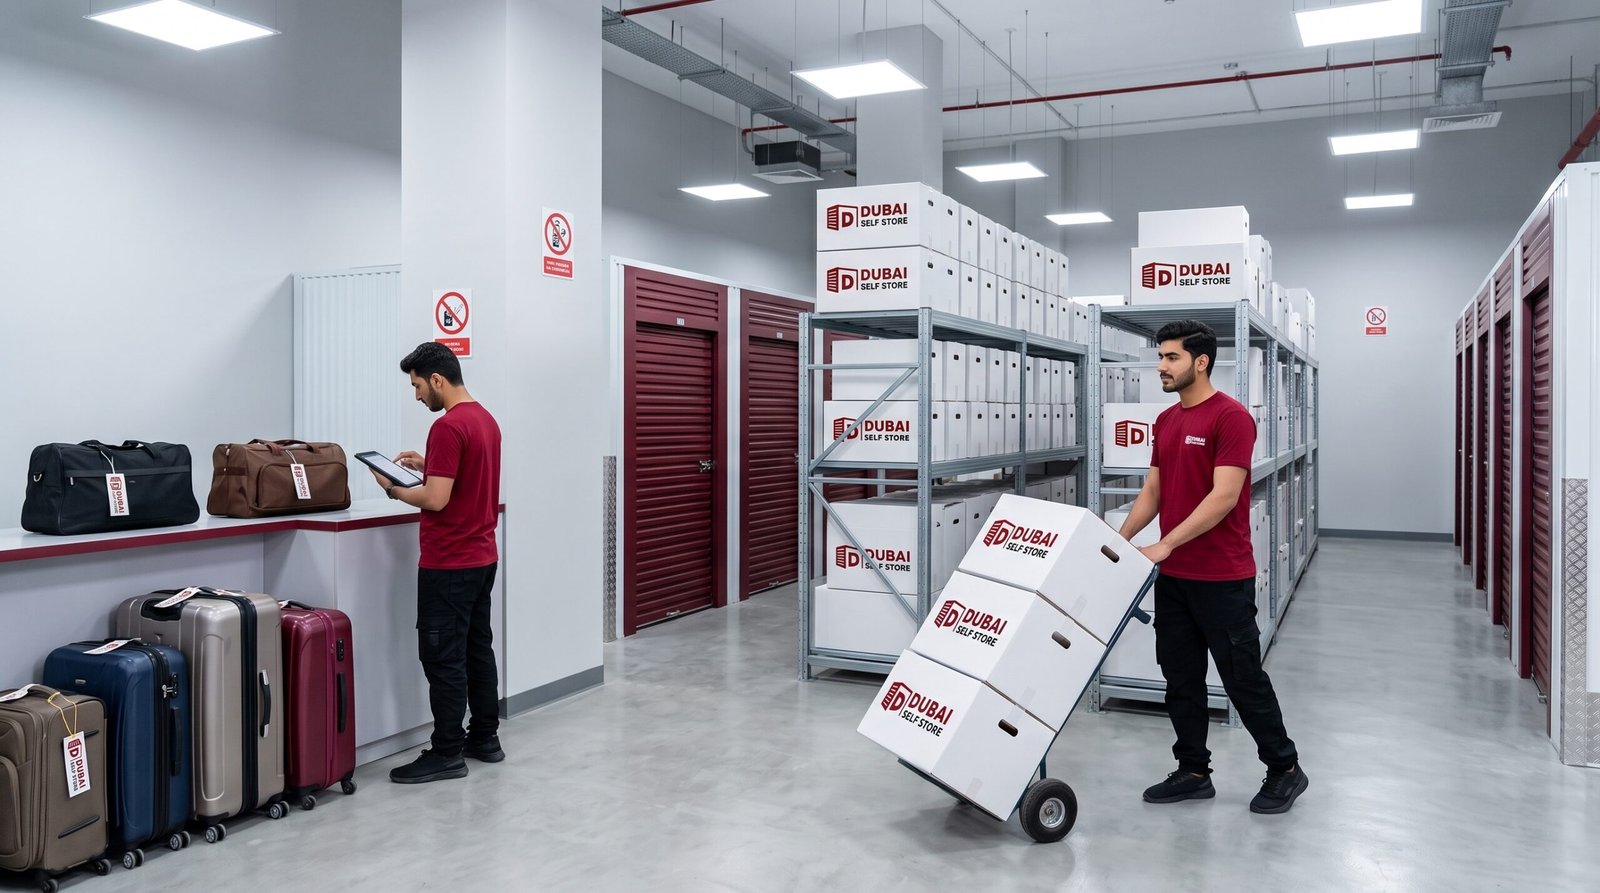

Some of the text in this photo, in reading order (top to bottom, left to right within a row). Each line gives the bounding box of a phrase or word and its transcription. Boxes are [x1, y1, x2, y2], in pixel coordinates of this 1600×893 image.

[861, 203, 907, 217] DUBAI
[860, 216, 908, 227] SELF STORE
[861, 267, 907, 281] DUBAI
[1180, 263, 1230, 276] DUBAI
[1202, 277, 1230, 285] STORE
[864, 420, 910, 432] DUBAI
[1012, 526, 1058, 548] DUBAI
[865, 548, 910, 562] DUBAI
[1006, 542, 1048, 558] SELF STORE
[885, 564, 911, 572] STORE
[962, 608, 1008, 636] DUBAI
[956, 626, 998, 647] SELF STORE
[908, 692, 954, 725] DUBAI
[902, 710, 944, 737] SELF STORE
[76, 759, 86, 788] DUBAI
